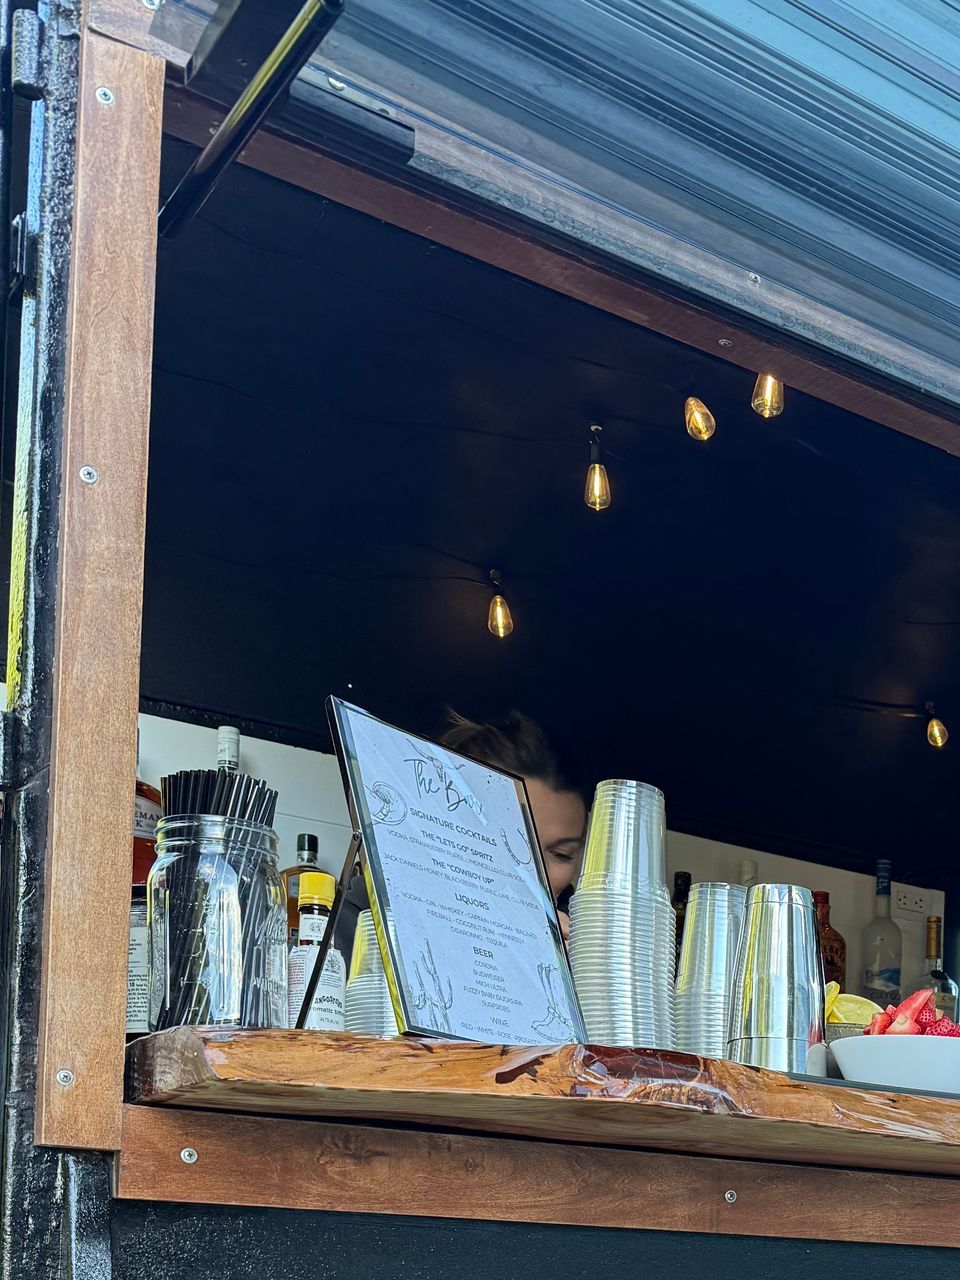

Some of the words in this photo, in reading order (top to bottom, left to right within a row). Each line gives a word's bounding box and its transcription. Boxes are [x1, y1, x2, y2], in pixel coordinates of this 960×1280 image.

[404, 759, 440, 799] The
[410, 808, 455, 831] SIGNATURE
[455, 825, 497, 846] COCKTAILS
[421, 830, 436, 841] THE
[432, 858, 446, 869] THE
[401, 891, 422, 902] VODKA
[455, 893, 489, 910] LIQUORS
[473, 947, 494, 959] BEER
[475, 960, 498, 971] CORONA
[473, 969, 504, 982] BUDWEISER
[464, 986, 480, 995] FUZZY
[461, 1022, 473, 1030] RED
[490, 1017, 509, 1027] WINE
